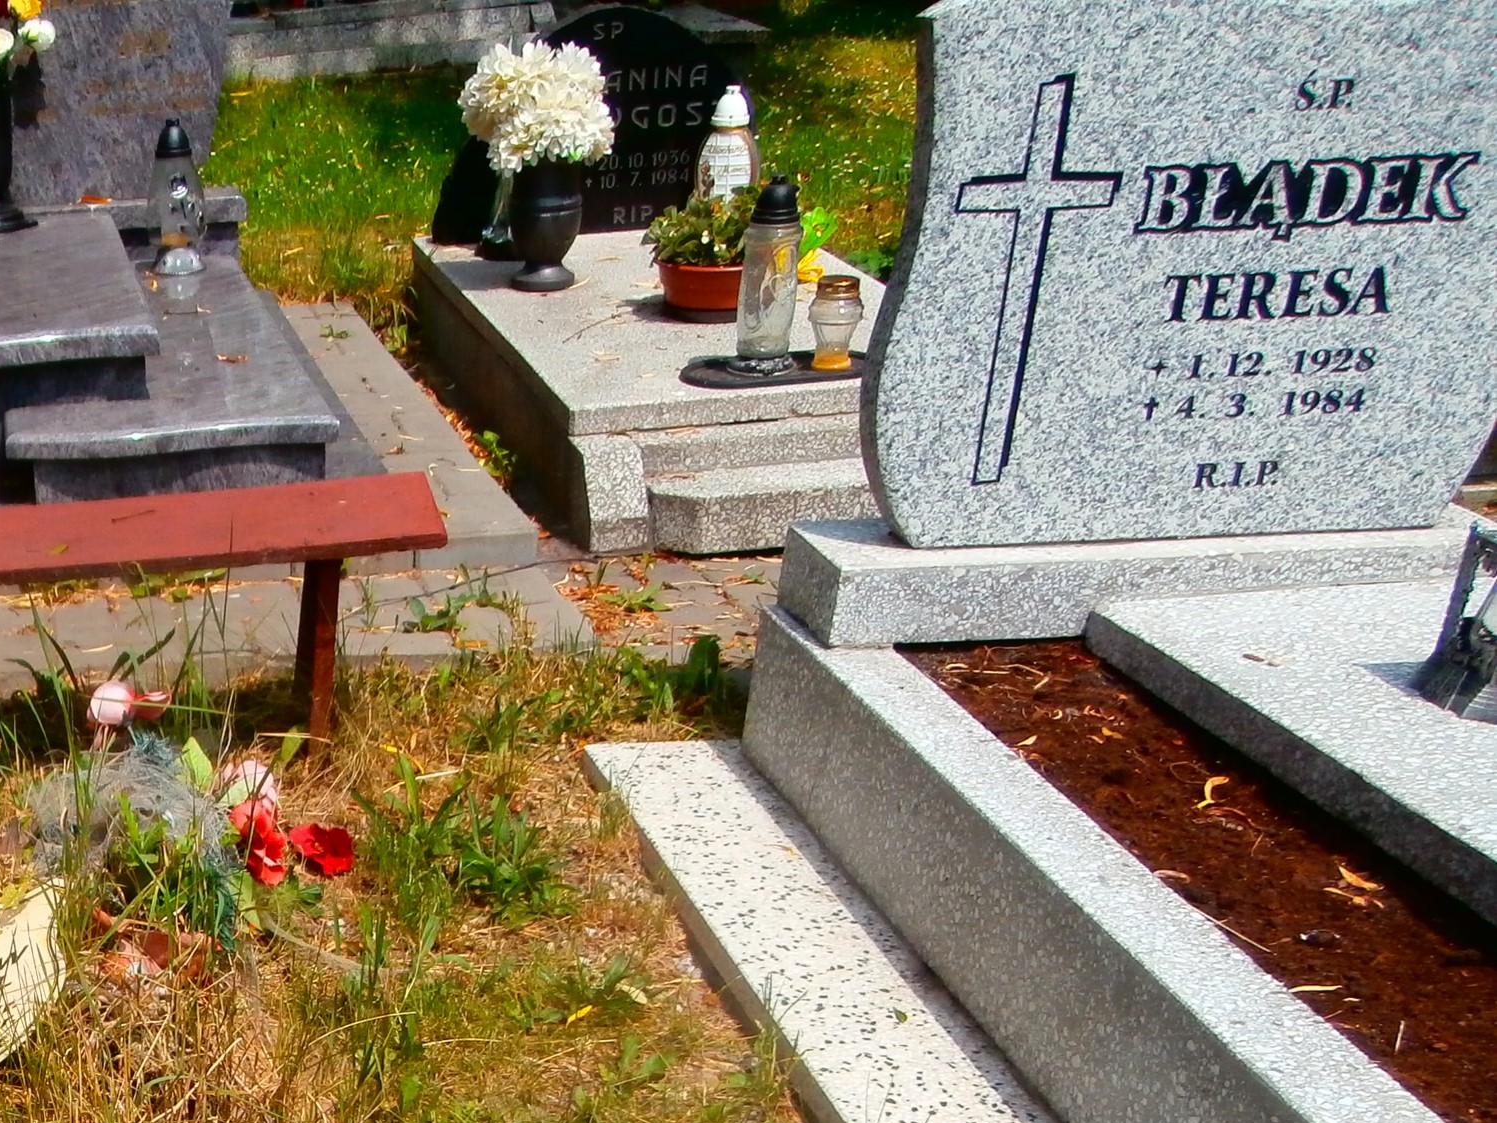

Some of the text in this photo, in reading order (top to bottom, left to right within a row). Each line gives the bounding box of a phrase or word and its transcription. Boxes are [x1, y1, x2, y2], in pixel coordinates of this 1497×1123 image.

[605, 65, 708, 93] ANINA
[652, 149, 690, 168] 1936
[651, 168, 689, 186] 1984
[612, 205, 653, 225] RIP
[1163, 265, 1391, 324] TERESA
[1291, 347, 1378, 375] 1928
[1276, 387, 1367, 417] 1984
[1192, 460, 1280, 488] R.I.P.
